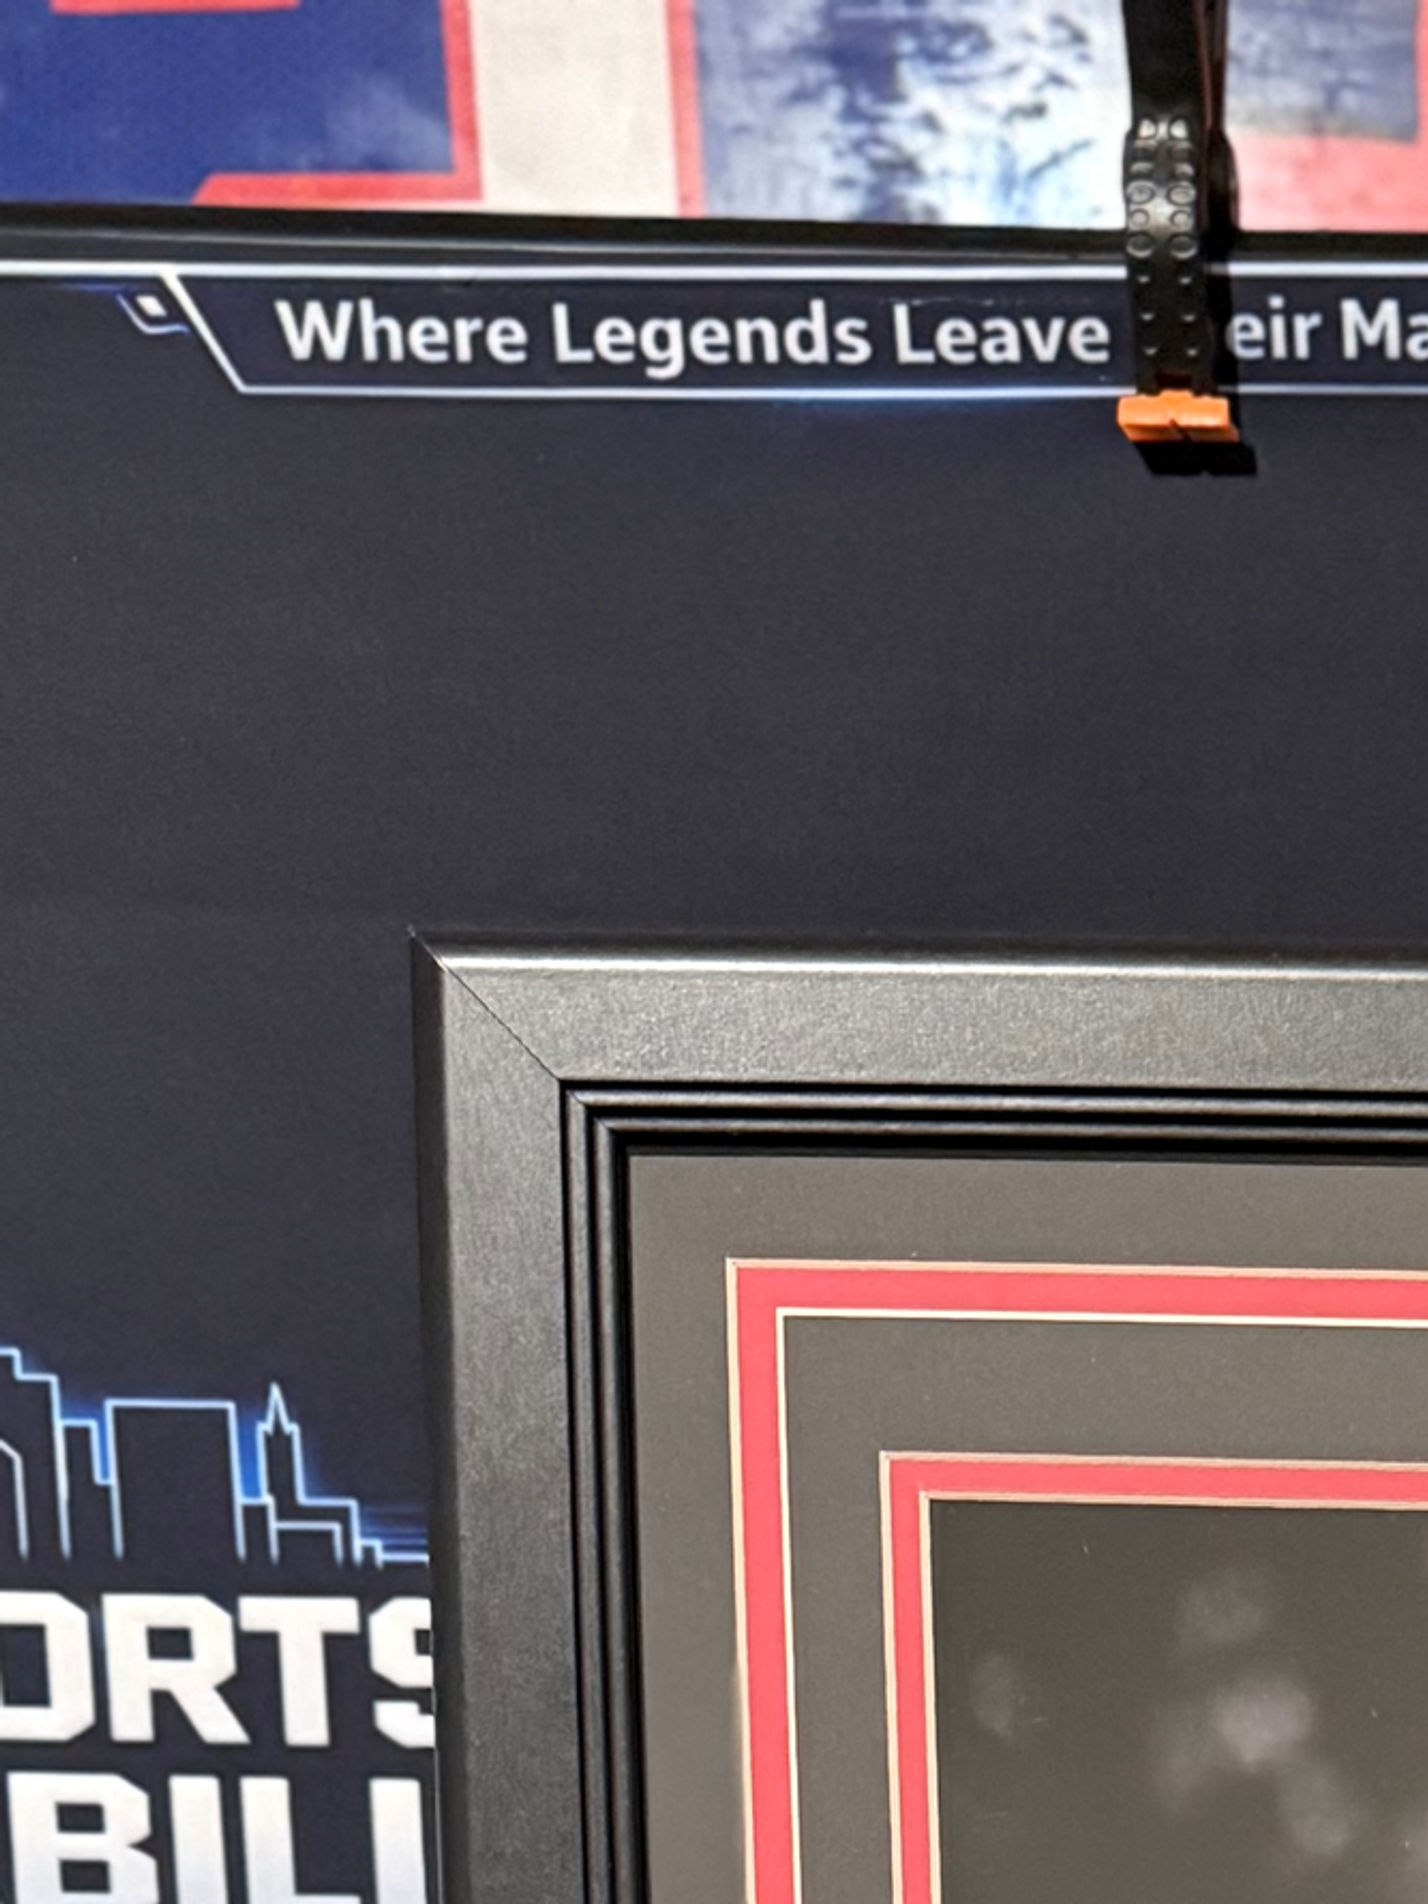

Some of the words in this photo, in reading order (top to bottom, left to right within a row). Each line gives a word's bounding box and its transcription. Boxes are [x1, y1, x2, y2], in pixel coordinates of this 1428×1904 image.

[274, 298, 527, 364] Where
[552, 299, 873, 379] Legends
[893, 303, 1111, 365] Leave
[1224, 295, 1322, 362] eir
